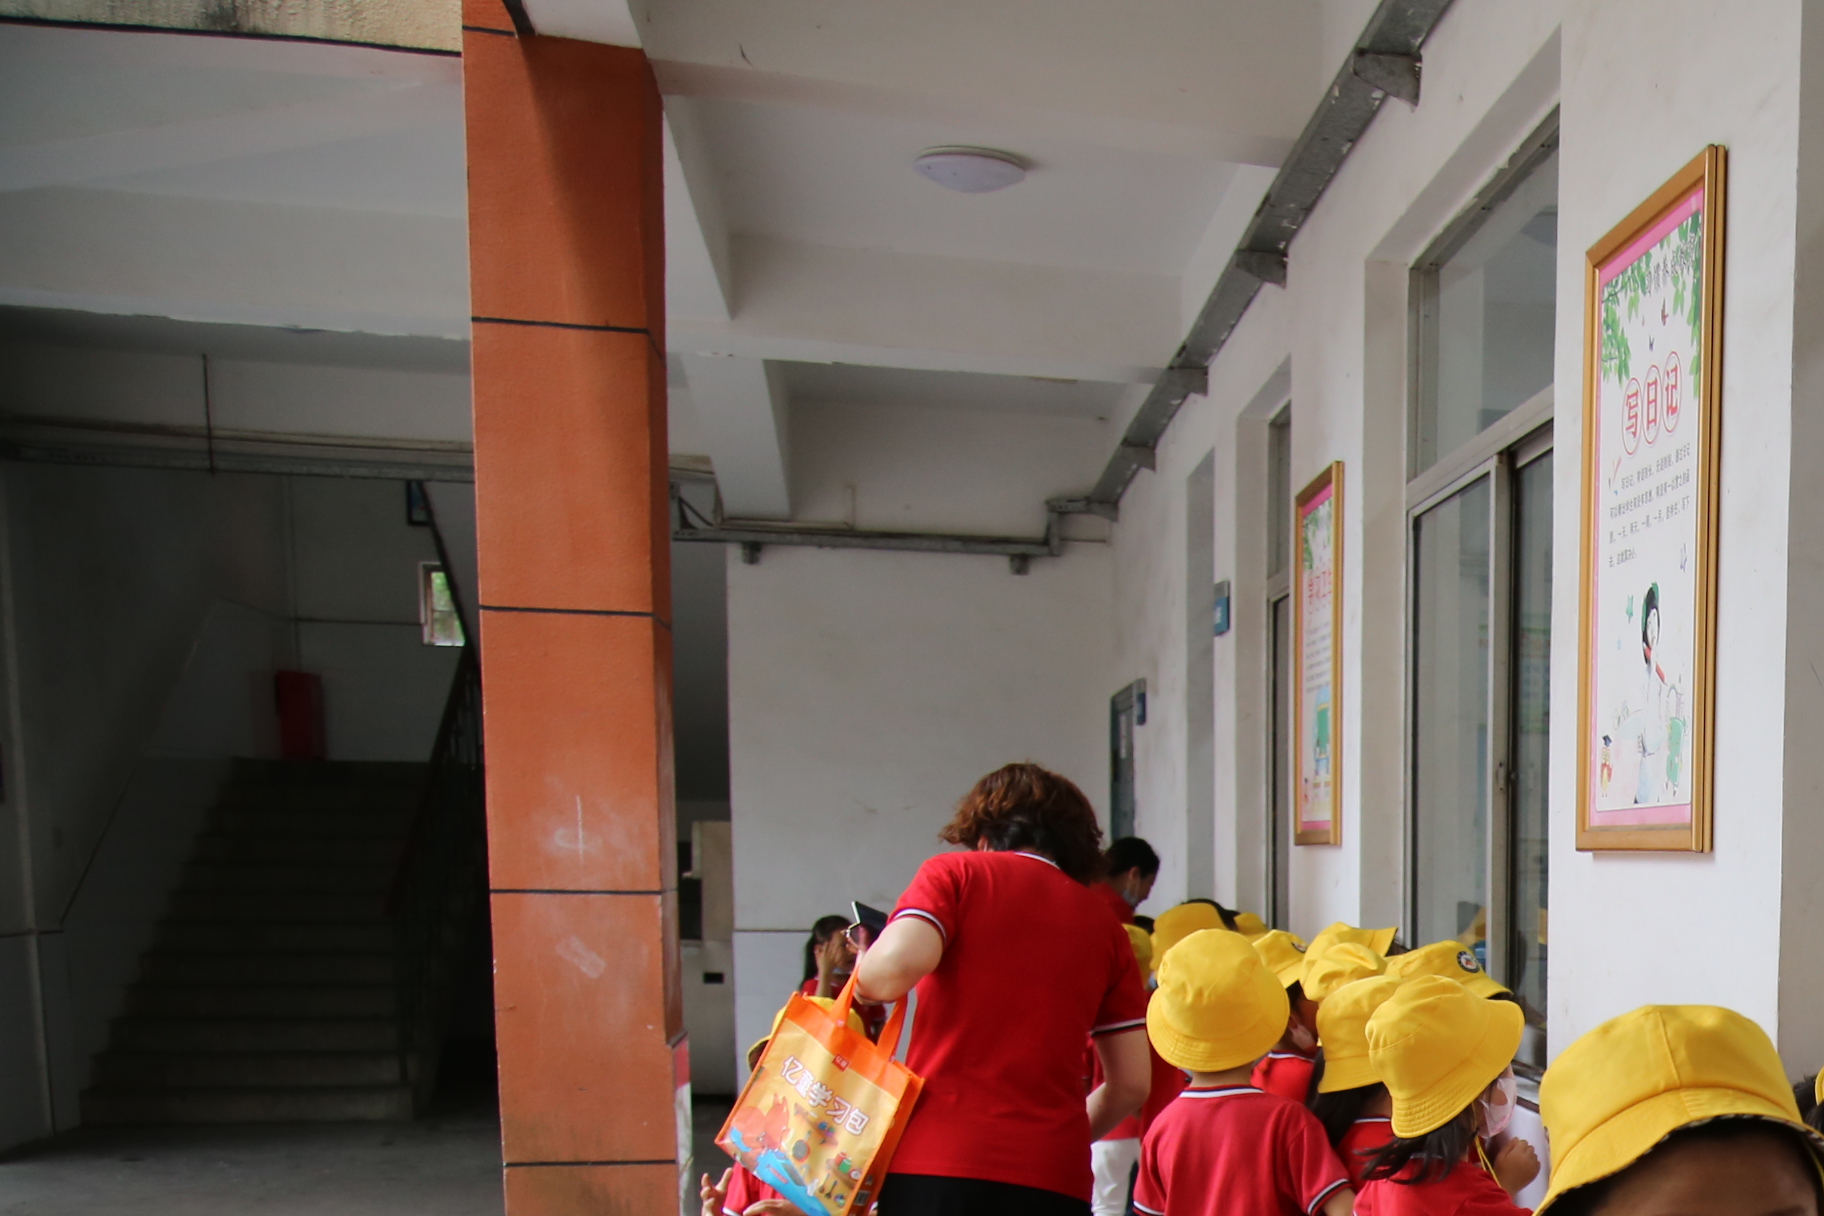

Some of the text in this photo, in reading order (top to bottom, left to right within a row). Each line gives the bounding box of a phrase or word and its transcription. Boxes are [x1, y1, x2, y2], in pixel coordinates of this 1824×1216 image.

[1625, 362, 1680, 440] 写日记
[781, 1055, 870, 1136] 亿童学习包
